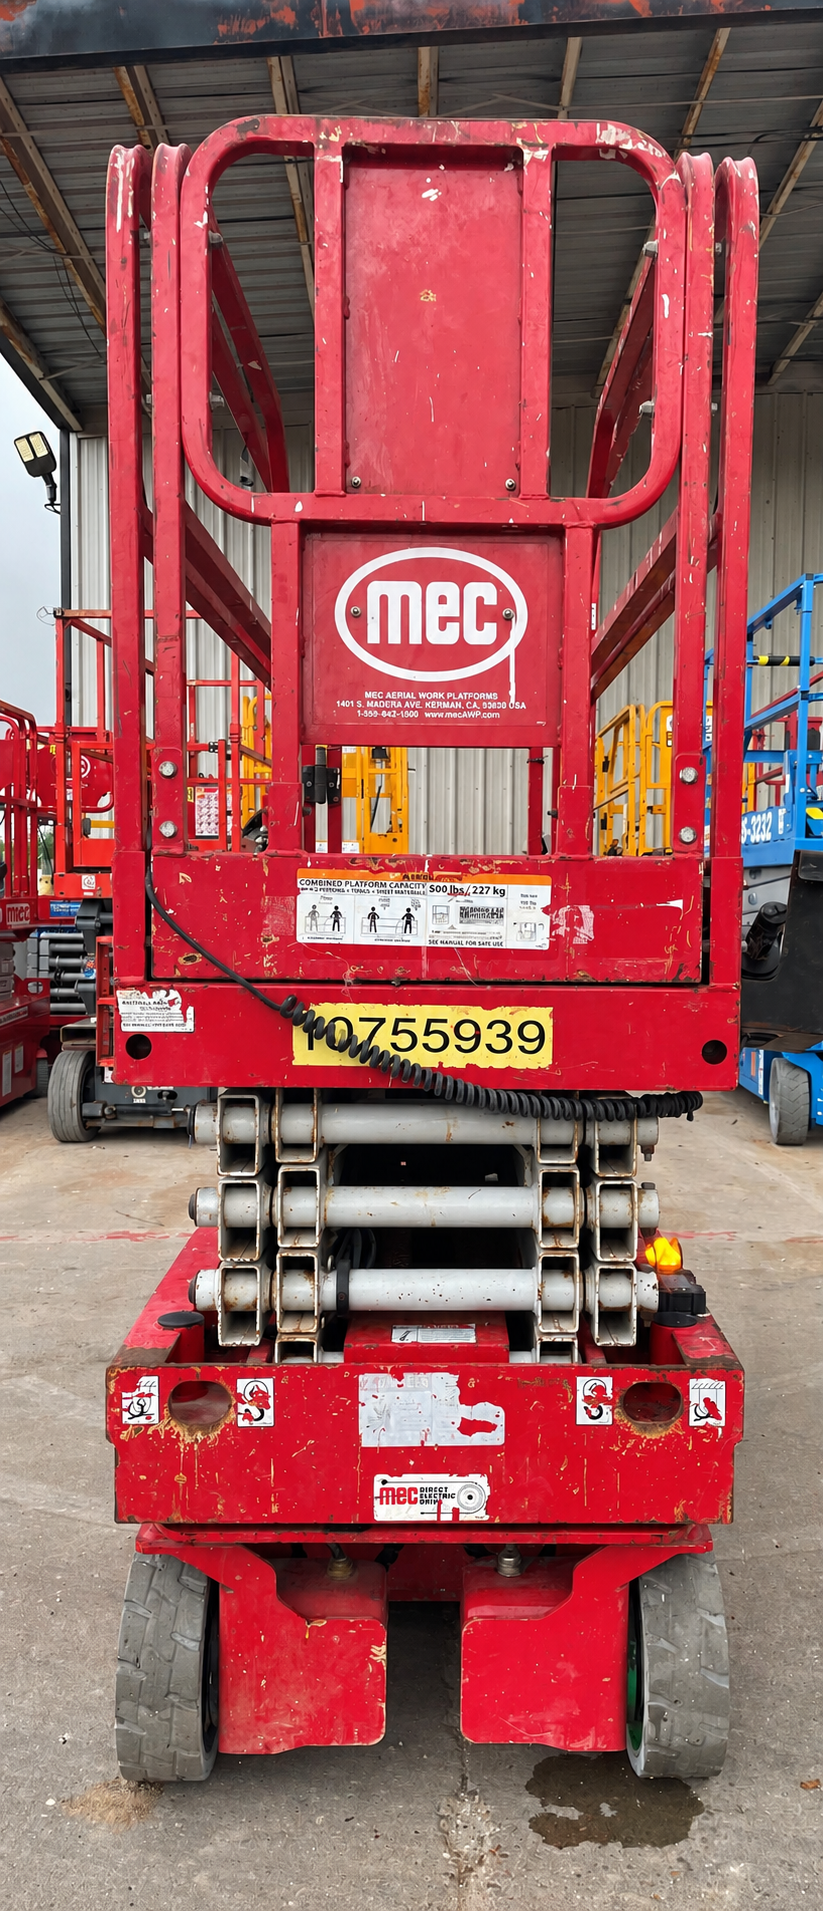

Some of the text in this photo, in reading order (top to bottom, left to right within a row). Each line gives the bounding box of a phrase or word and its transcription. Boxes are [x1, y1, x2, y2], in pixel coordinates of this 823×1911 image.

[367, 580, 498, 645] mec
[364, 691, 384, 699] MEC
[419, 692, 445, 700] WORK
[336, 700, 354, 708] 1401
[509, 702, 526, 710] USA
[299, 879, 342, 888] COMBINED
[345, 880, 387, 888] PLATFORM
[389, 881, 426, 889] CAPACITY
[472, 886, 490, 895] 227
[493, 886, 506, 897] kg
[307, 1016, 546, 1054] 10755939
[379, 1487, 418, 1505] mec
